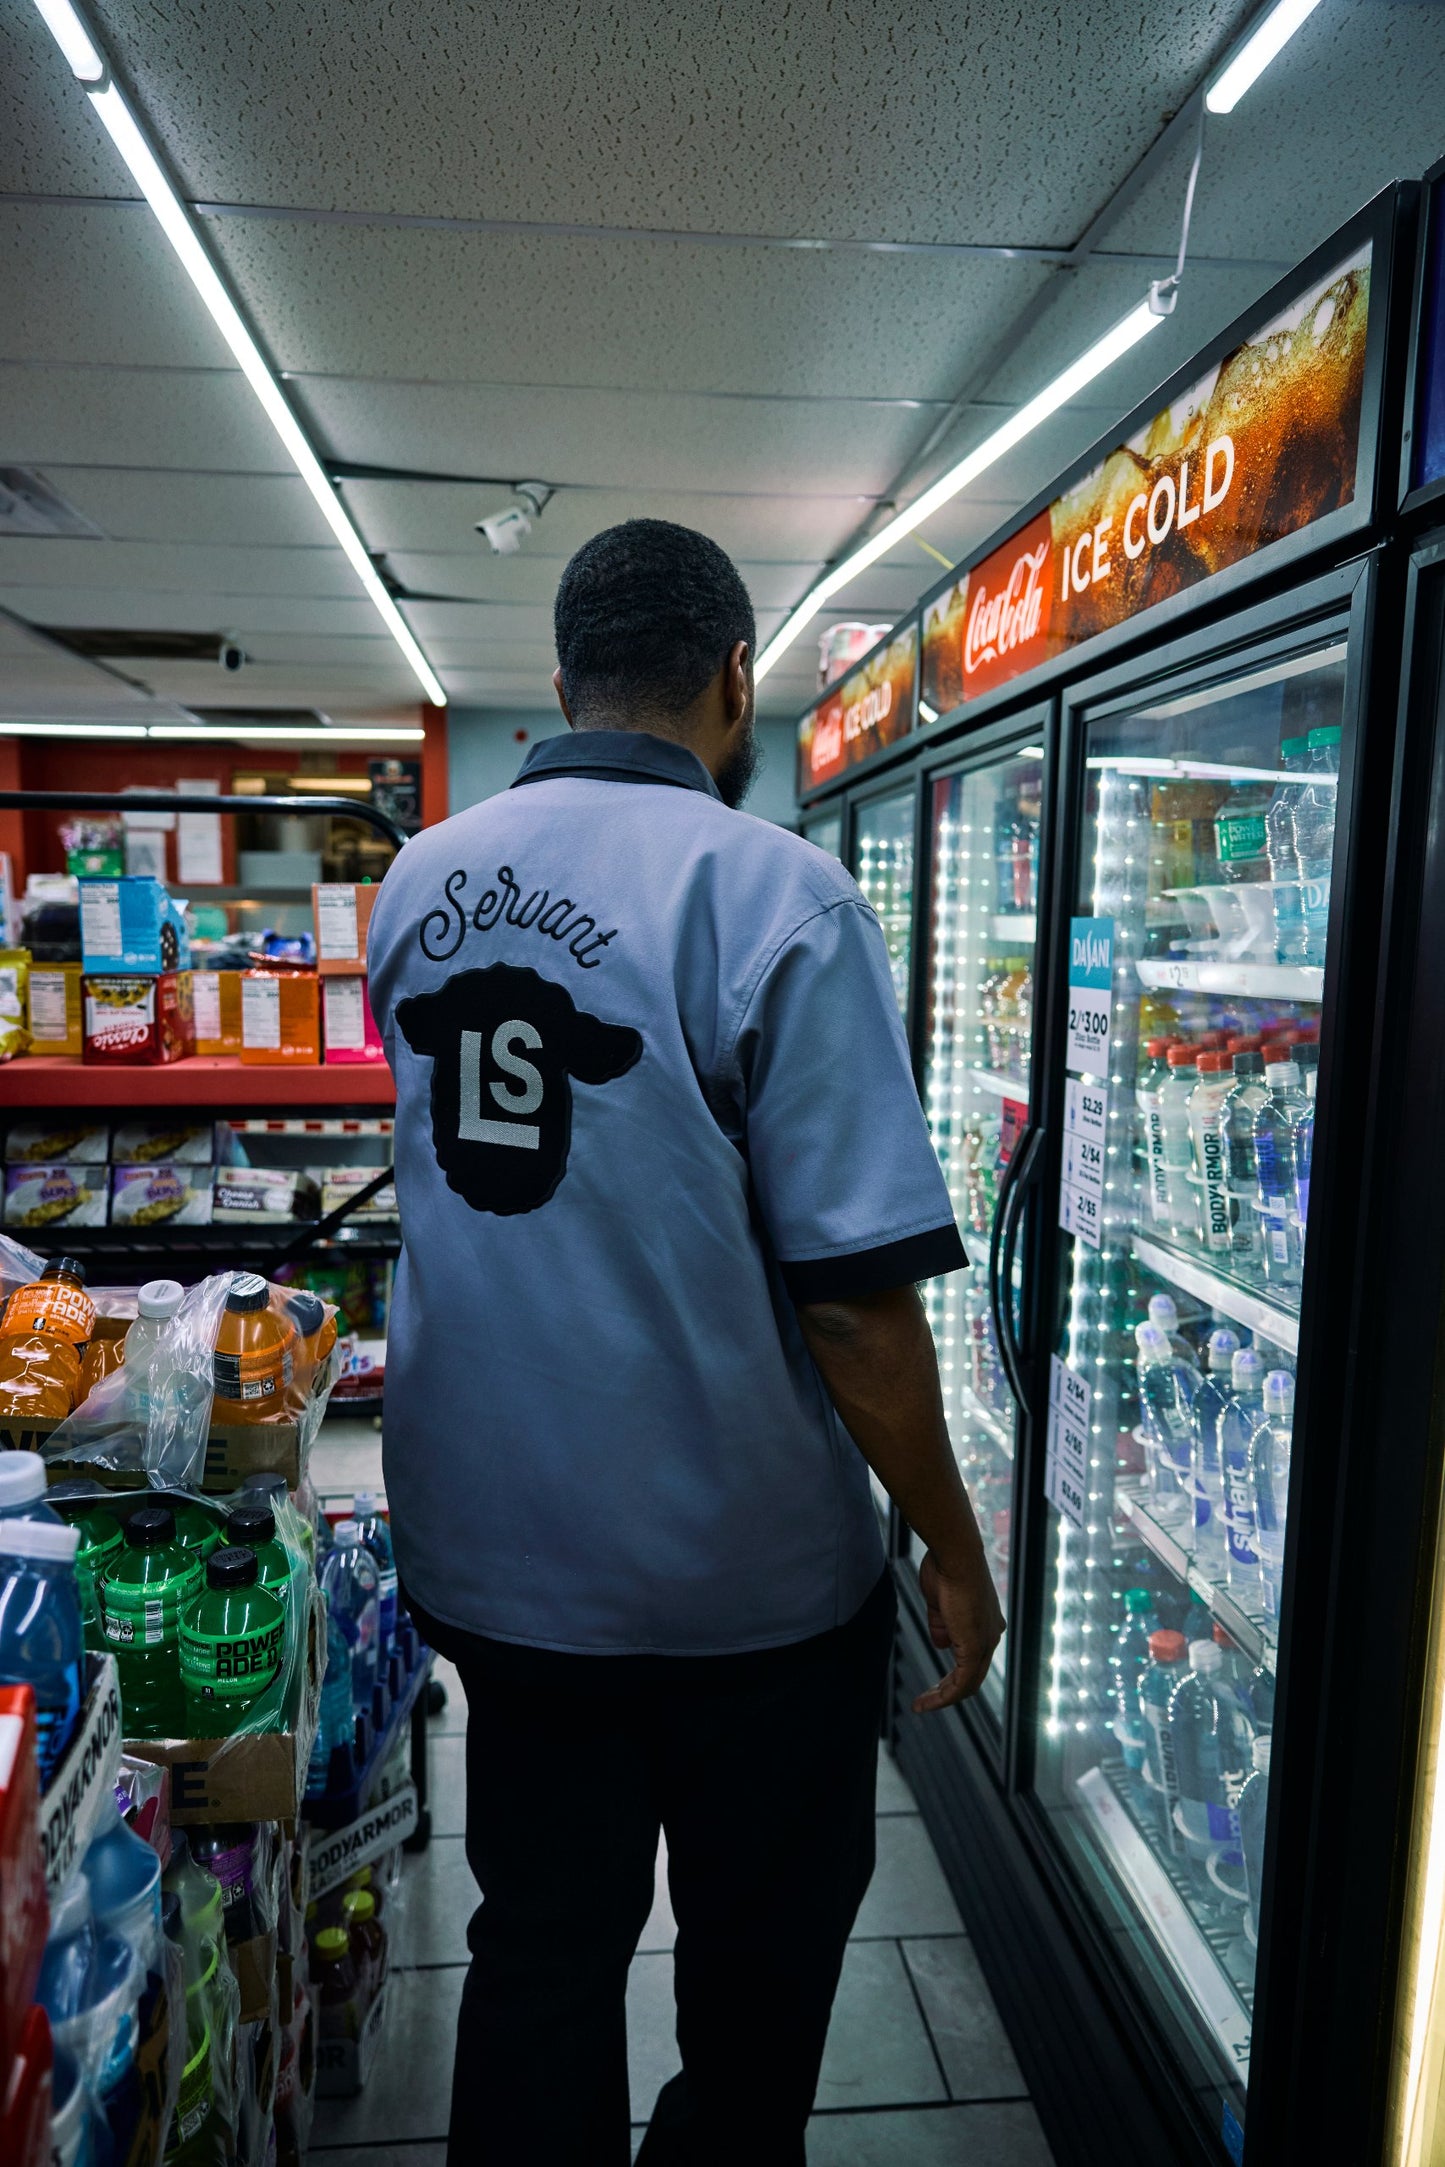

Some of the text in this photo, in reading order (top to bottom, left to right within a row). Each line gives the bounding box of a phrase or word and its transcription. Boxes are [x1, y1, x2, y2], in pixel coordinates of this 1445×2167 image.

[1061, 434, 1235, 602] ICE COLD
[419, 865, 618, 969] Servant
[1072, 930, 1110, 976] DASANI
[93, 1025, 149, 1051] Classic
[458, 1019, 544, 1150] LS
[218, 1187, 254, 1199] Cheese
[52, 1301, 87, 1327] ADE
[57, 1287, 97, 1320] POW
[1226, 1464, 1251, 1552] smart
[216, 1652, 263, 1677] ADE
